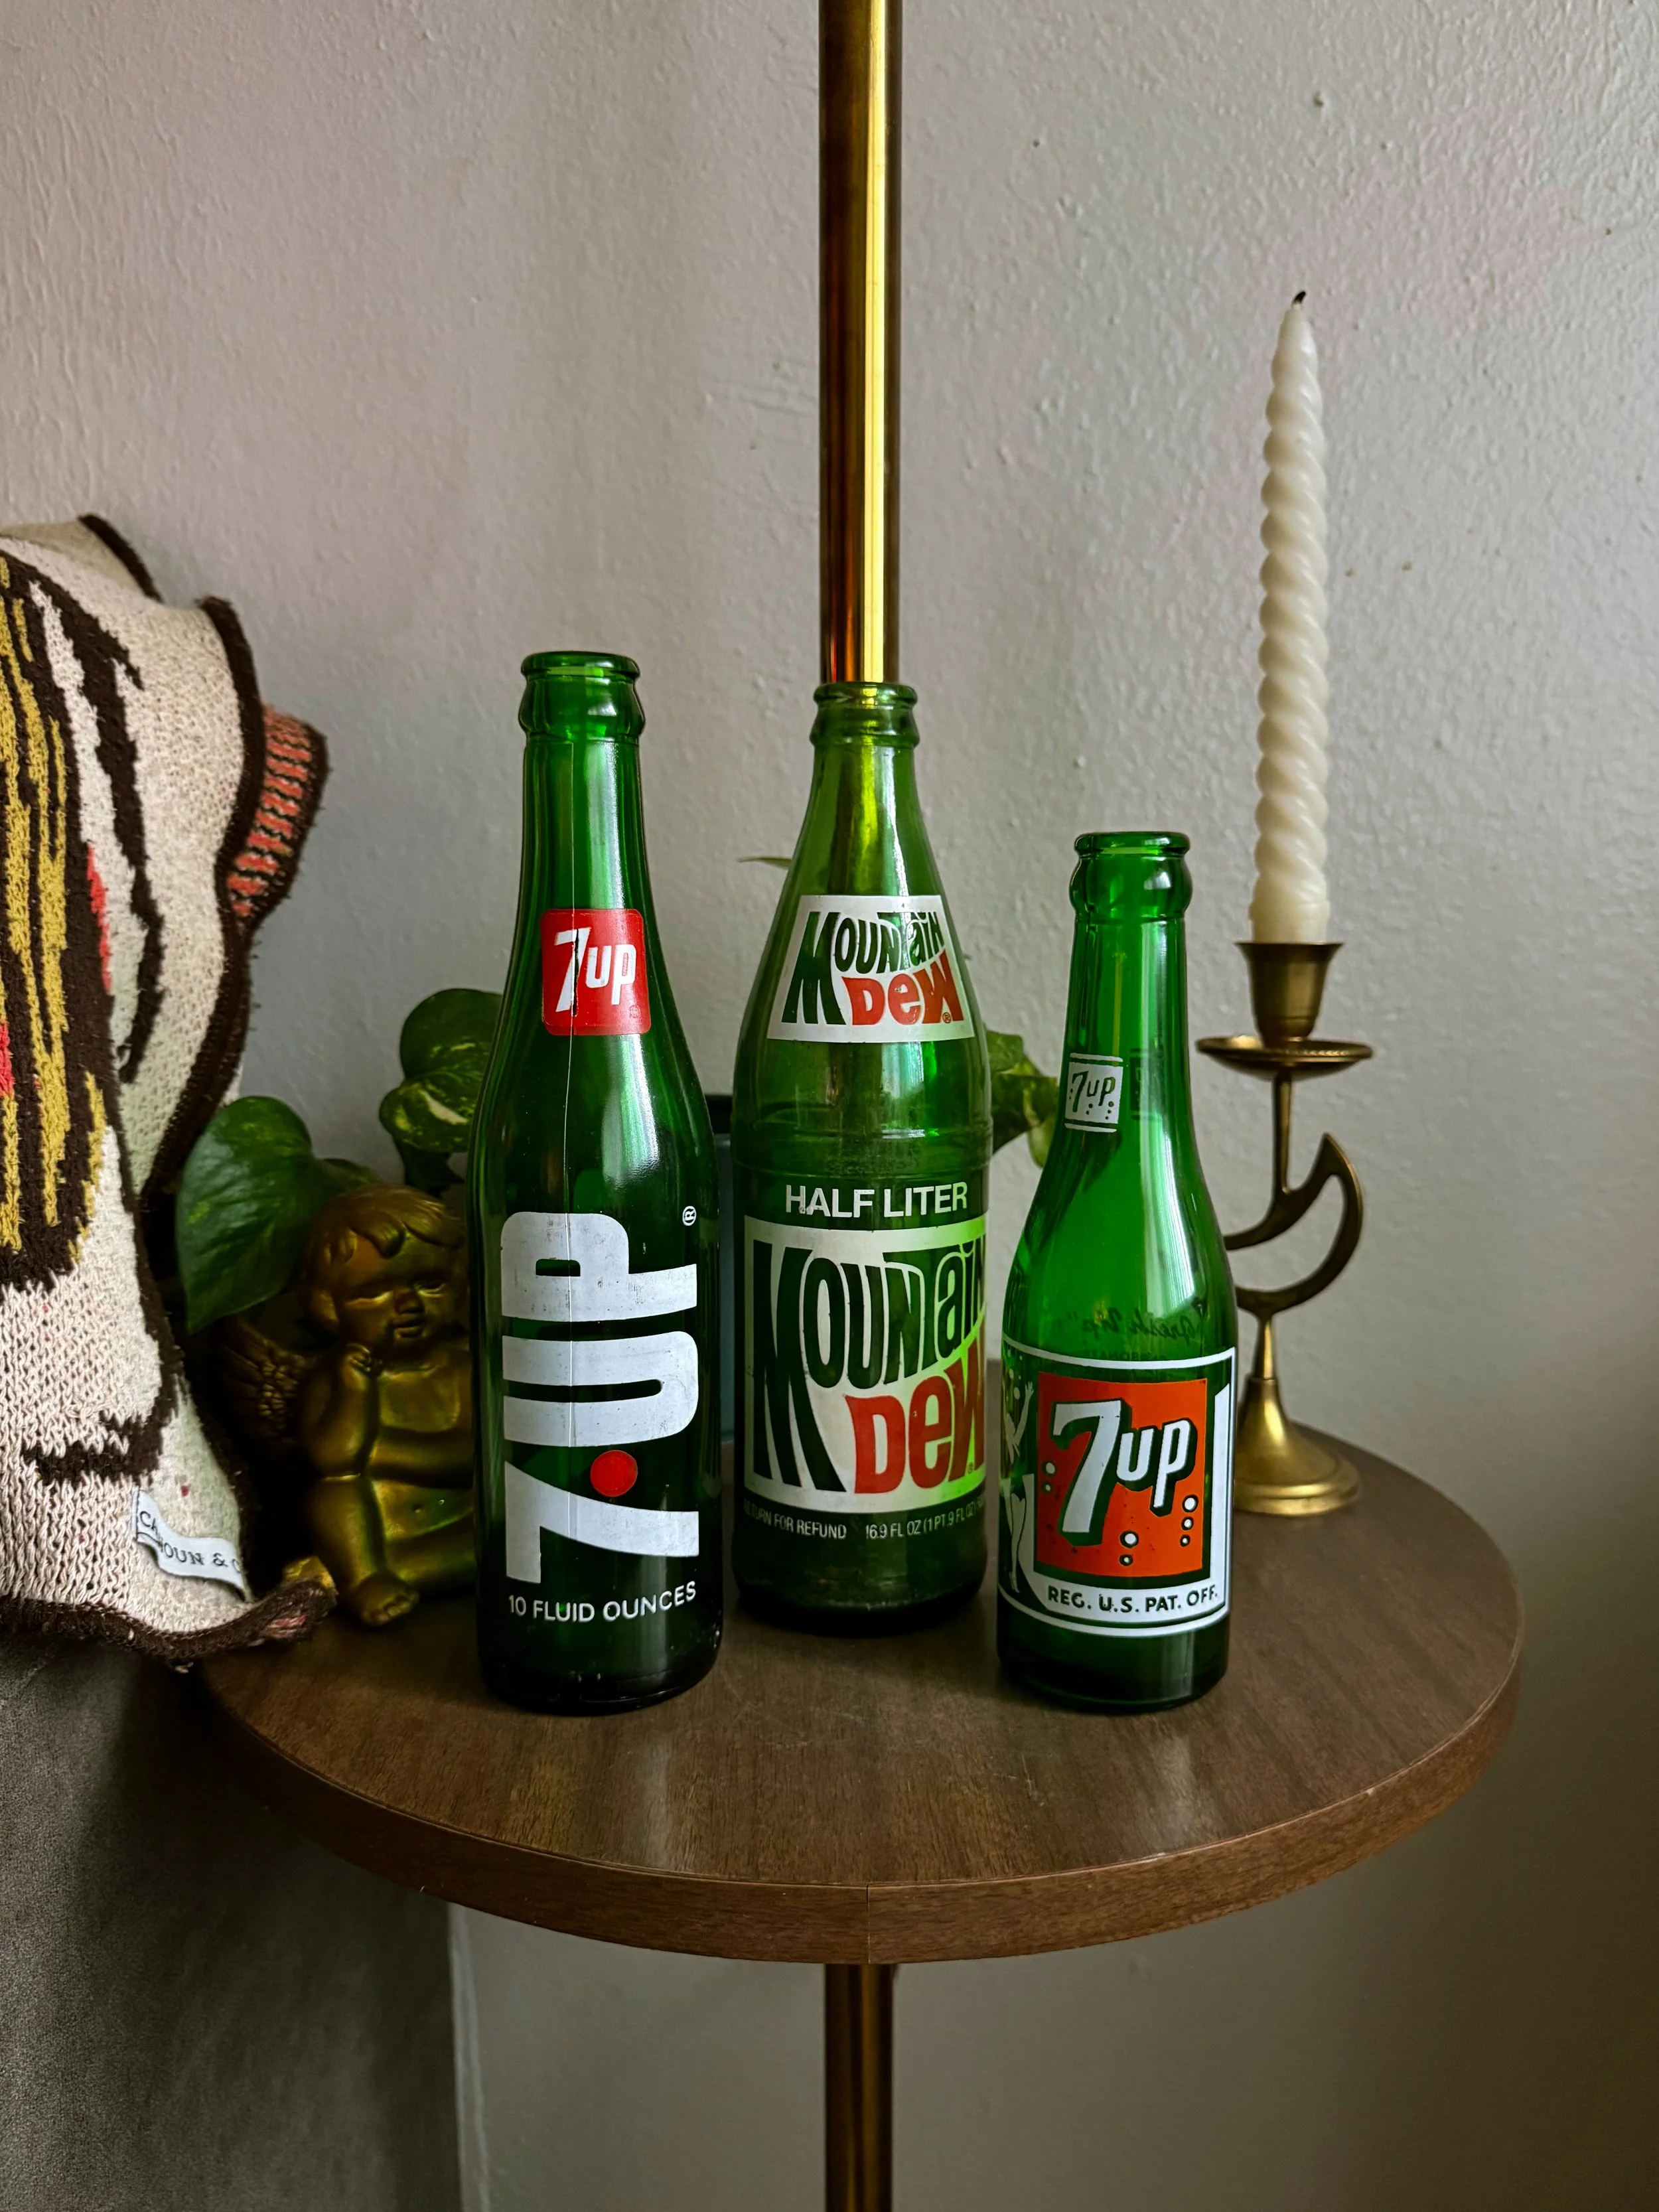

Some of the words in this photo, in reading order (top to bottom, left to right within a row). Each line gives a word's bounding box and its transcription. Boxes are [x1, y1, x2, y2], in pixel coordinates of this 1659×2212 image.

[785, 1184, 875, 1218] HALF
[883, 1181, 968, 1218] LITER
[774, 1512, 794, 1533] FOR
[796, 1518, 847, 1540] REFUND
[890, 1522, 904, 1538] FL
[906, 1520, 922, 1536] OZ
[508, 1594, 527, 1617] 10
[532, 1599, 595, 1623] FLUID
[602, 1580, 697, 1623] OUNCES
[1047, 1585, 1092, 1611] REG.
[1099, 1594, 1140, 1613] U.S.
[1145, 1594, 1182, 1613] PAT.
[1187, 1584, 1219, 1607] OFF.
